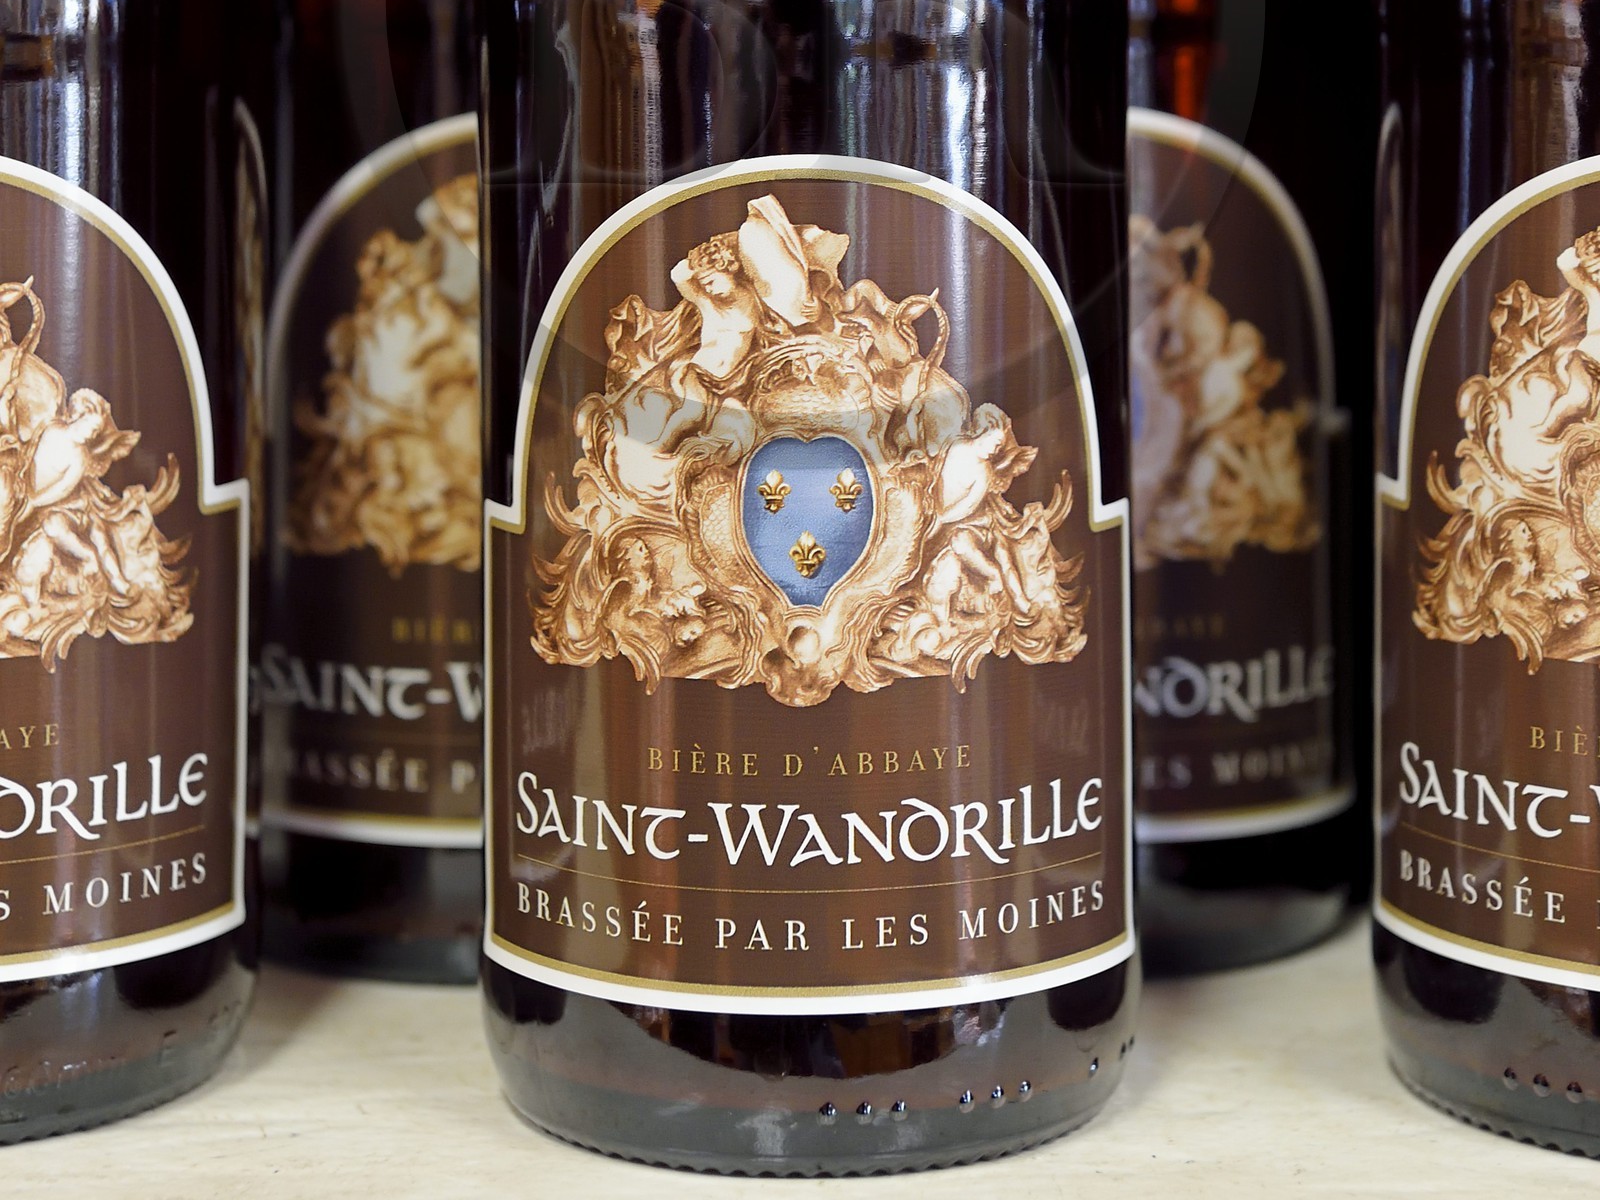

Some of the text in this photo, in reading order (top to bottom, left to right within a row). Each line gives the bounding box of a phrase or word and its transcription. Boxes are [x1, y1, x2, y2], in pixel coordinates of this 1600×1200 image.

[648, 743, 973, 777] BIÈRE D'ABBAYE
[1529, 726, 1600, 758] BIÈ
[516, 771, 1103, 868] SAINT-WANDRILLE
[1400, 741, 1600, 839] SAINT-
[42, 852, 206, 915] MOINES
[517, 879, 1104, 952] BRASSÉE PAR LES MOINES
[1400, 849, 1566, 924] BRASSÉE
